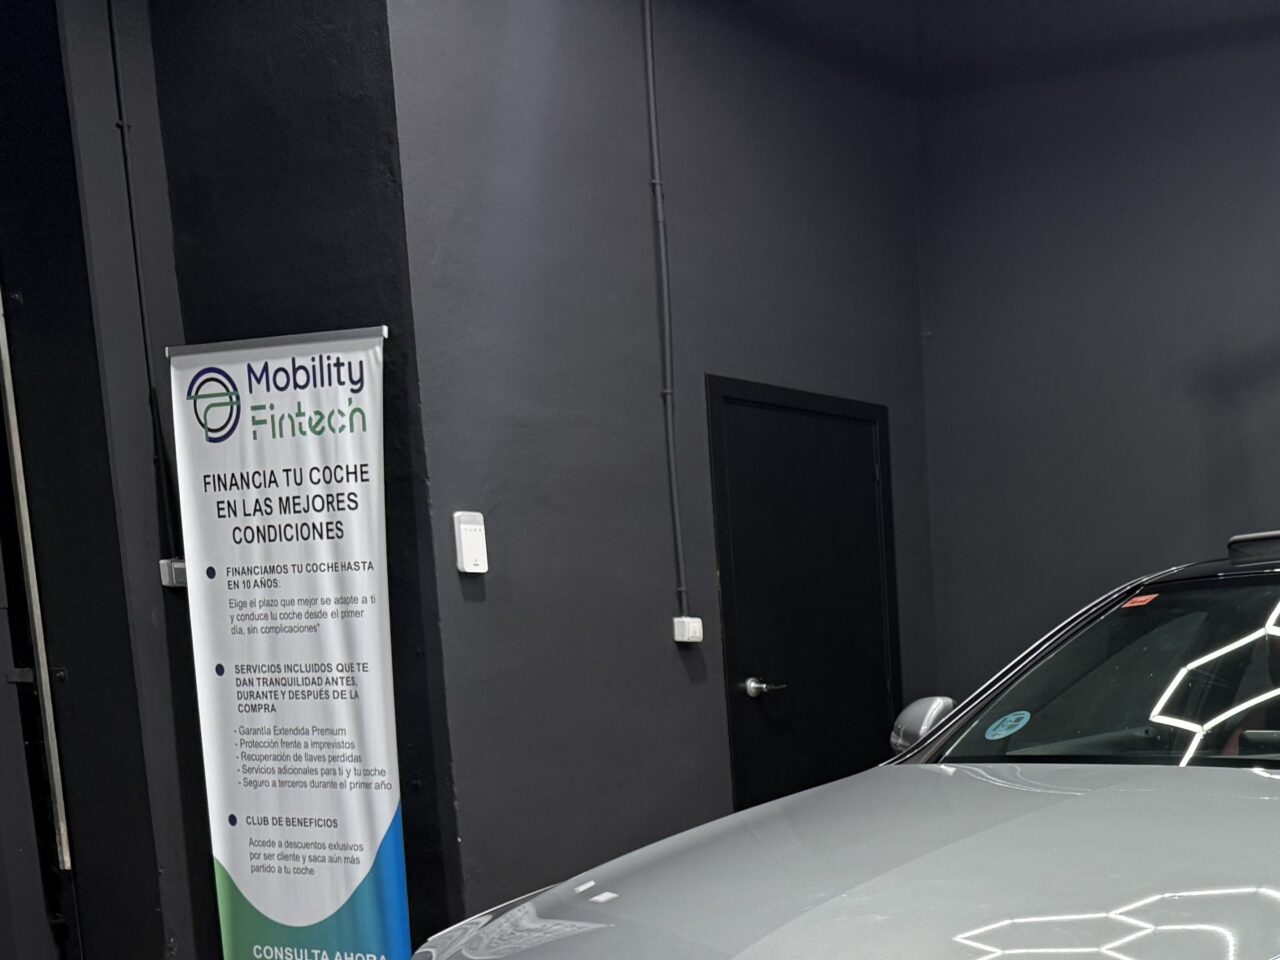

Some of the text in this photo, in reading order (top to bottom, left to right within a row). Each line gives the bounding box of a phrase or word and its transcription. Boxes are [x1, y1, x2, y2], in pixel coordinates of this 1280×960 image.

[246, 354, 364, 394] Mobility
[250, 397, 367, 440] Fintech
[203, 463, 370, 493] FINANCIA TU COCHE
[216, 492, 359, 518] EN LAS MEJORES
[232, 520, 344, 545] CONDICIONES
[226, 560, 375, 577] FINANCIAMOS TU COCHE HASTA
[227, 577, 281, 590] EN 10 AÑOS:
[228, 594, 376, 611] Elige el plazo que mejor se adapte a ti
[229, 614, 235, 625] y
[236, 612, 269, 622] conduce
[270, 610, 278, 621] tu
[279, 610, 303, 620] coche
[304, 608, 328, 620] desde
[331, 608, 339, 619] el
[247, 623, 258, 634] sin
[234, 662, 369, 674] SERVICIOS INCLUIDOS QUE TE
[235, 677, 254, 687] DAN
[256, 676, 323, 687] TRANQUILIDAD
[236, 687, 360, 700] DURANTE Y DESPUÉS DE LA
[238, 703, 276, 713] COMPRA
[273, 725, 310, 736] Extendida
[311, 725, 347, 736] Premium
[240, 738, 356, 751] Protección frente a imprevistos
[241, 751, 362, 764] Recuperación de llaves perdidas
[242, 764, 276, 775] Servicios
[278, 765, 319, 775] adicionales
[320, 767, 337, 777] para
[346, 768, 352, 778] y
[354, 766, 362, 776] tu
[362, 766, 386, 777] coche
[243, 777, 392, 791] Seguro a terceros durante el primer año
[246, 815, 339, 829] CLUB DE BENEFICIOS
[249, 837, 276, 848] Accede
[278, 840, 283, 848] a
[284, 838, 326, 850] descuentos
[249, 852, 261, 861] por
[263, 852, 275, 861] ser
[277, 851, 300, 862] cliente
[301, 856, 307, 864] y
[308, 855, 326, 863] saca
[250, 863, 315, 875] partido a tu coche
